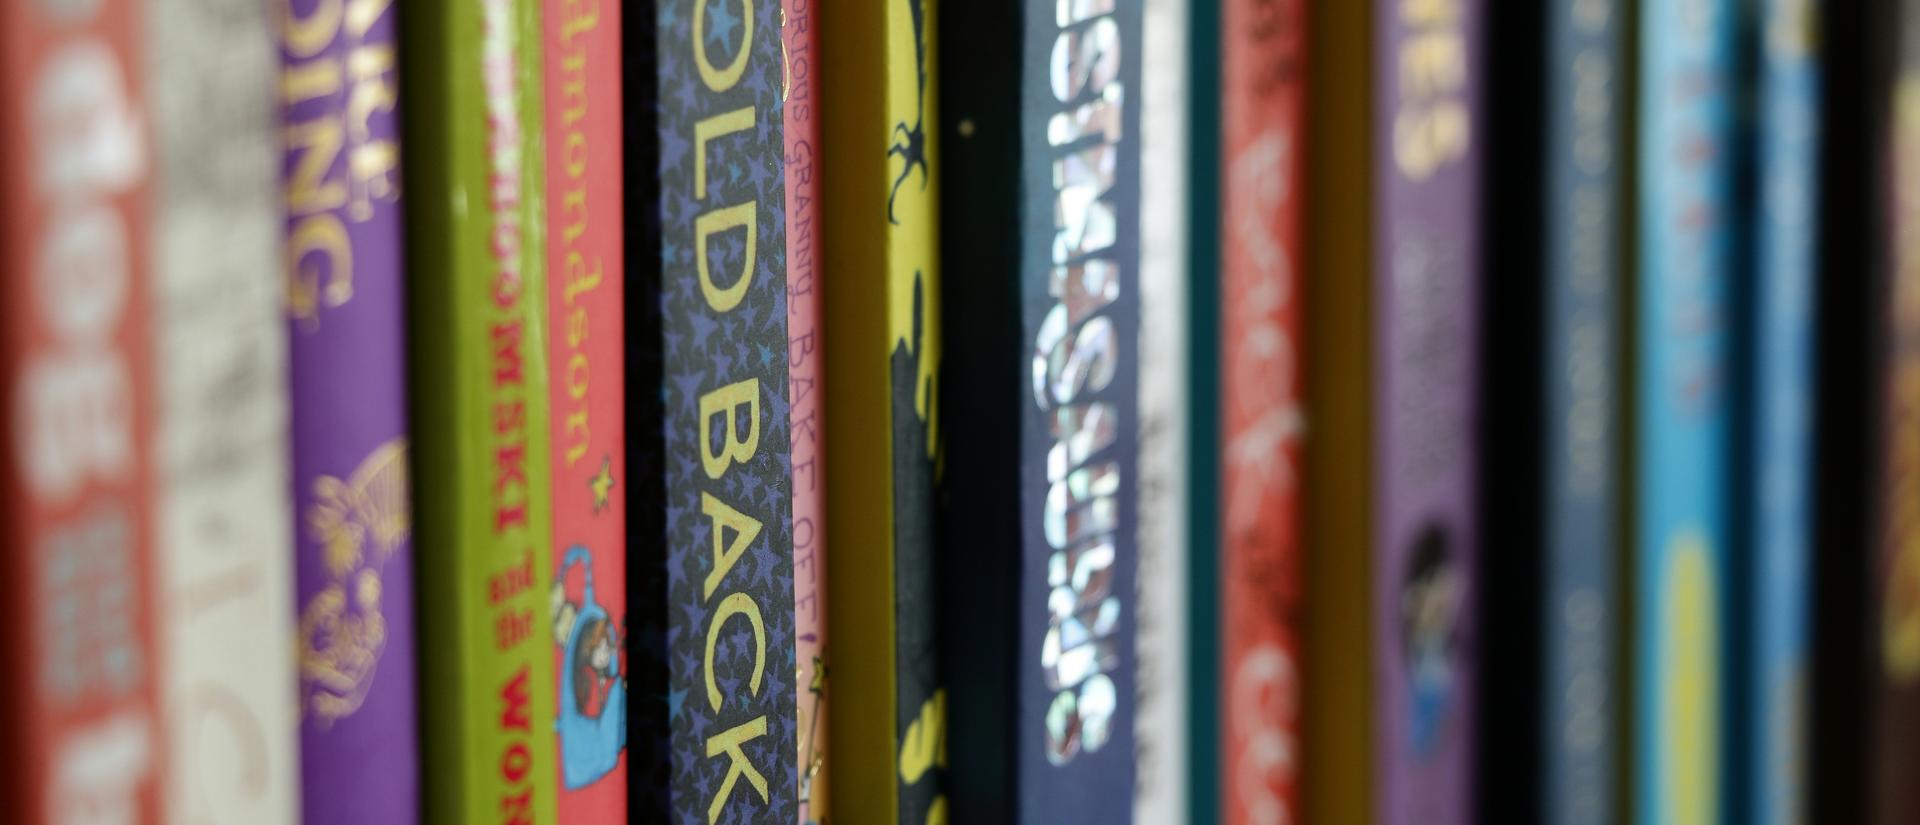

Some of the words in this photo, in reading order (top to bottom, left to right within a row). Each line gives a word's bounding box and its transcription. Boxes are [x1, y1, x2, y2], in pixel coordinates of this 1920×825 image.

[560, 0, 603, 467] dmondson
[785, 141, 815, 315] GRANNY
[789, 330, 818, 497] BAKE
[698, 377, 769, 825] BACK
[793, 517, 818, 645] OFF!
